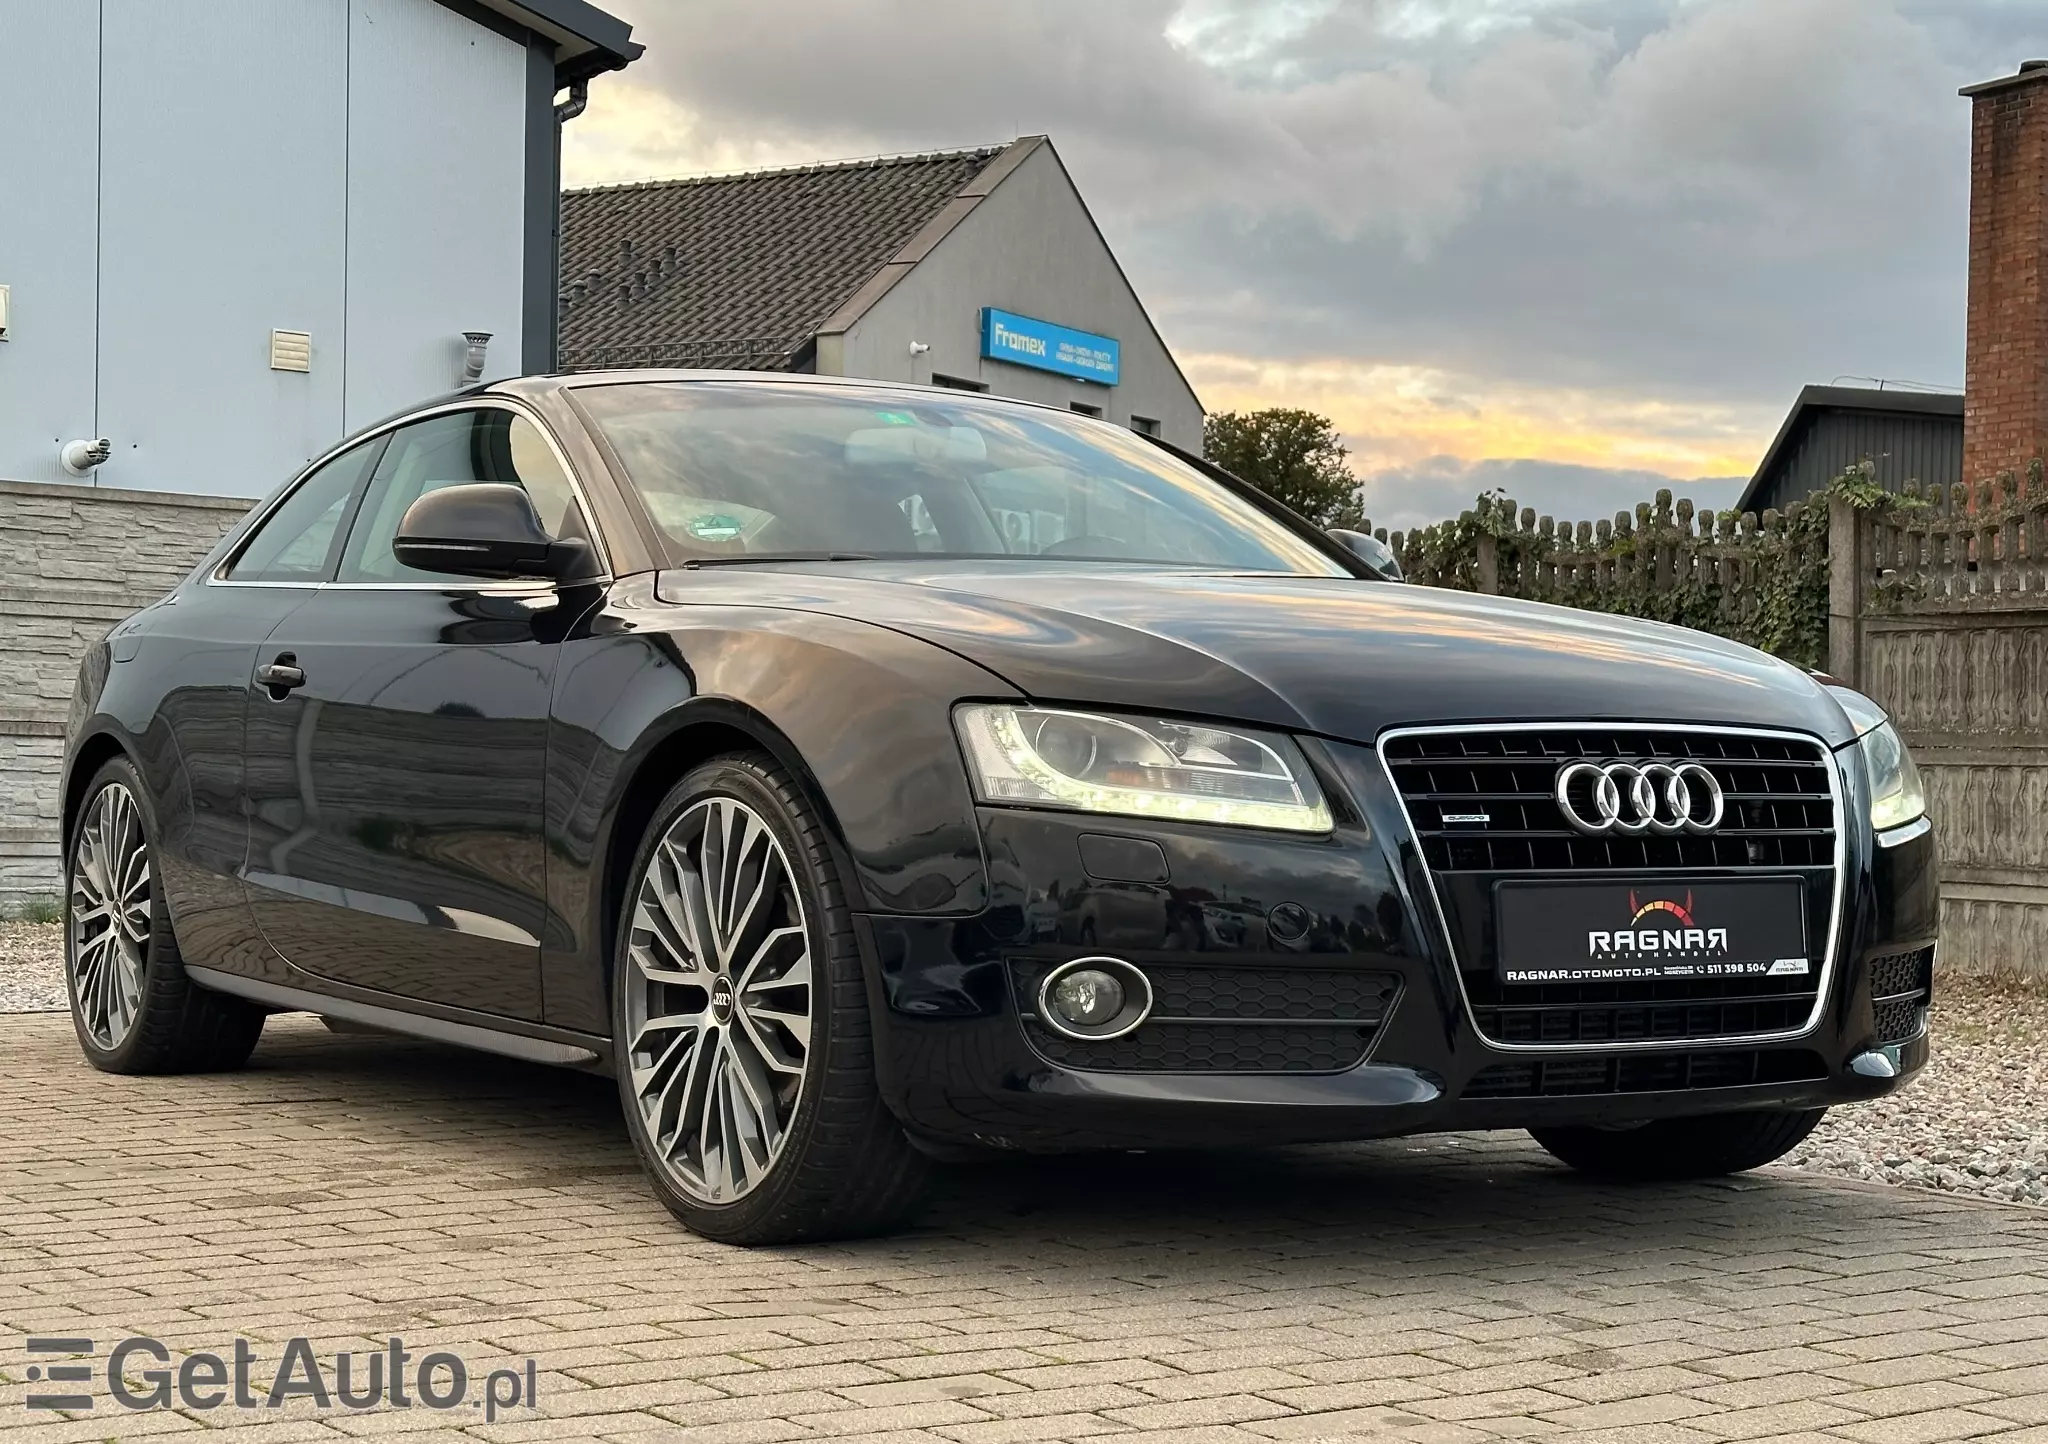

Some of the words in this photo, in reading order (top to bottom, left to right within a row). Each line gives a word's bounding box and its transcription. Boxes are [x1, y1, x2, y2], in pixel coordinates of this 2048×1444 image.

[994, 323, 1046, 357] Framex
[1506, 968, 1662, 981] RAGNAR.OTOMOTO.PL
[1707, 964, 1722, 974] 511
[1724, 963, 1744, 974] 398
[1746, 962, 1766, 973] 504
